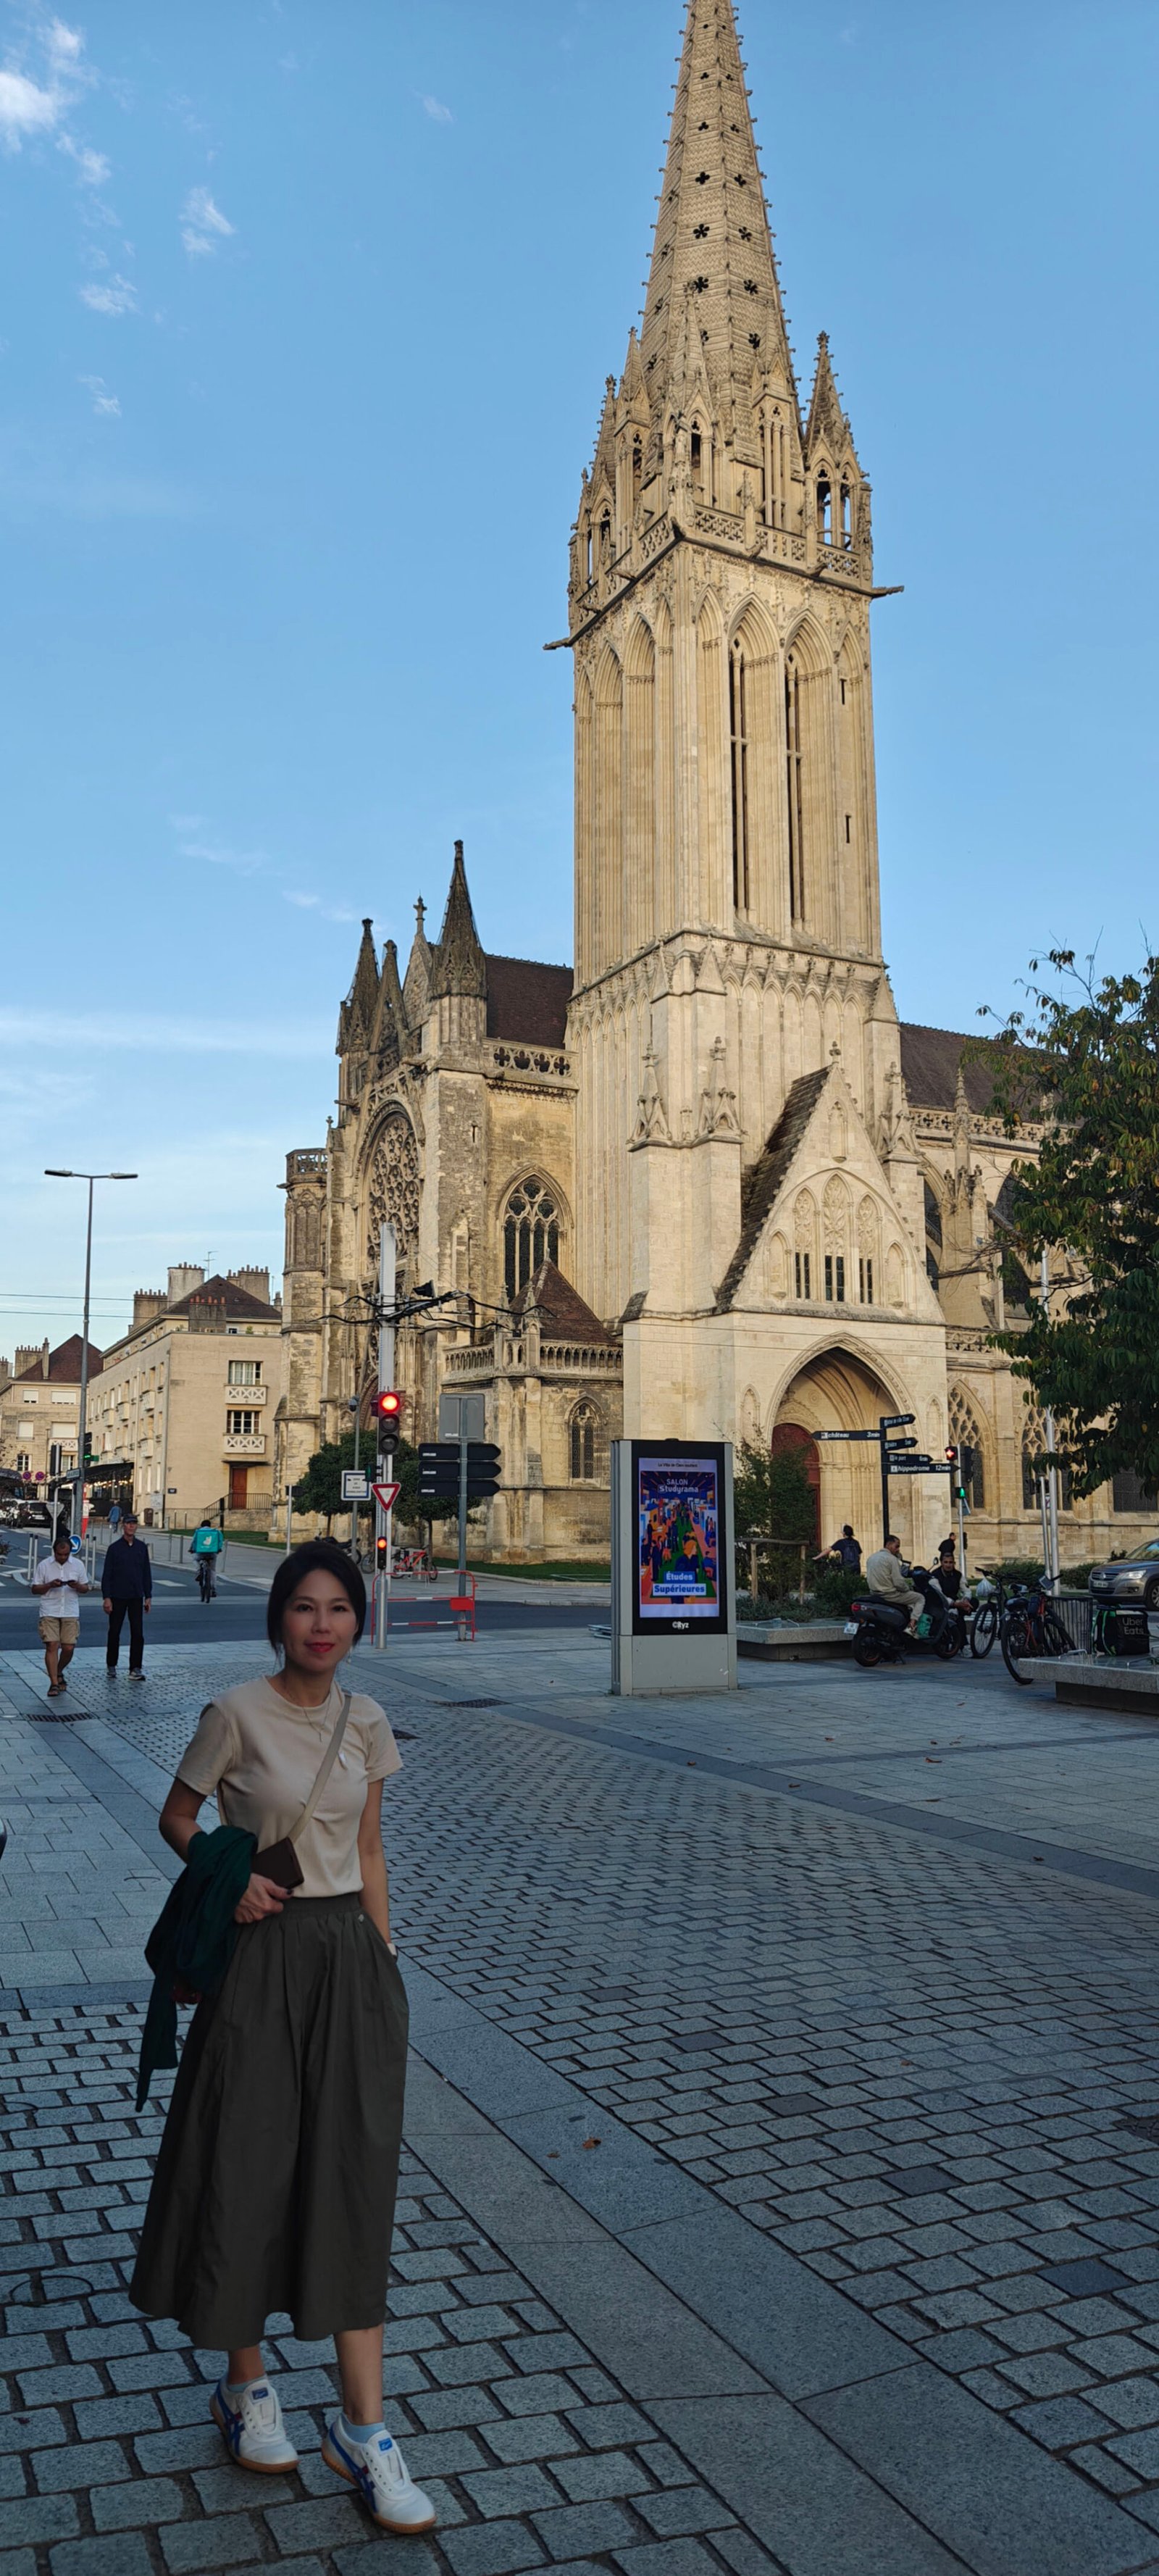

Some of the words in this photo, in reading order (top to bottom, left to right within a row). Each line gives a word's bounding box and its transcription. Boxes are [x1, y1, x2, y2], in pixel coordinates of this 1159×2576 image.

[659, 1485, 699, 1494] Studyrama
[666, 1571, 693, 1580] Études
[654, 1585, 705, 1594] Supérieures
[672, 1621, 690, 1630] Cityz
[1122, 1617, 1143, 1626] Uber
